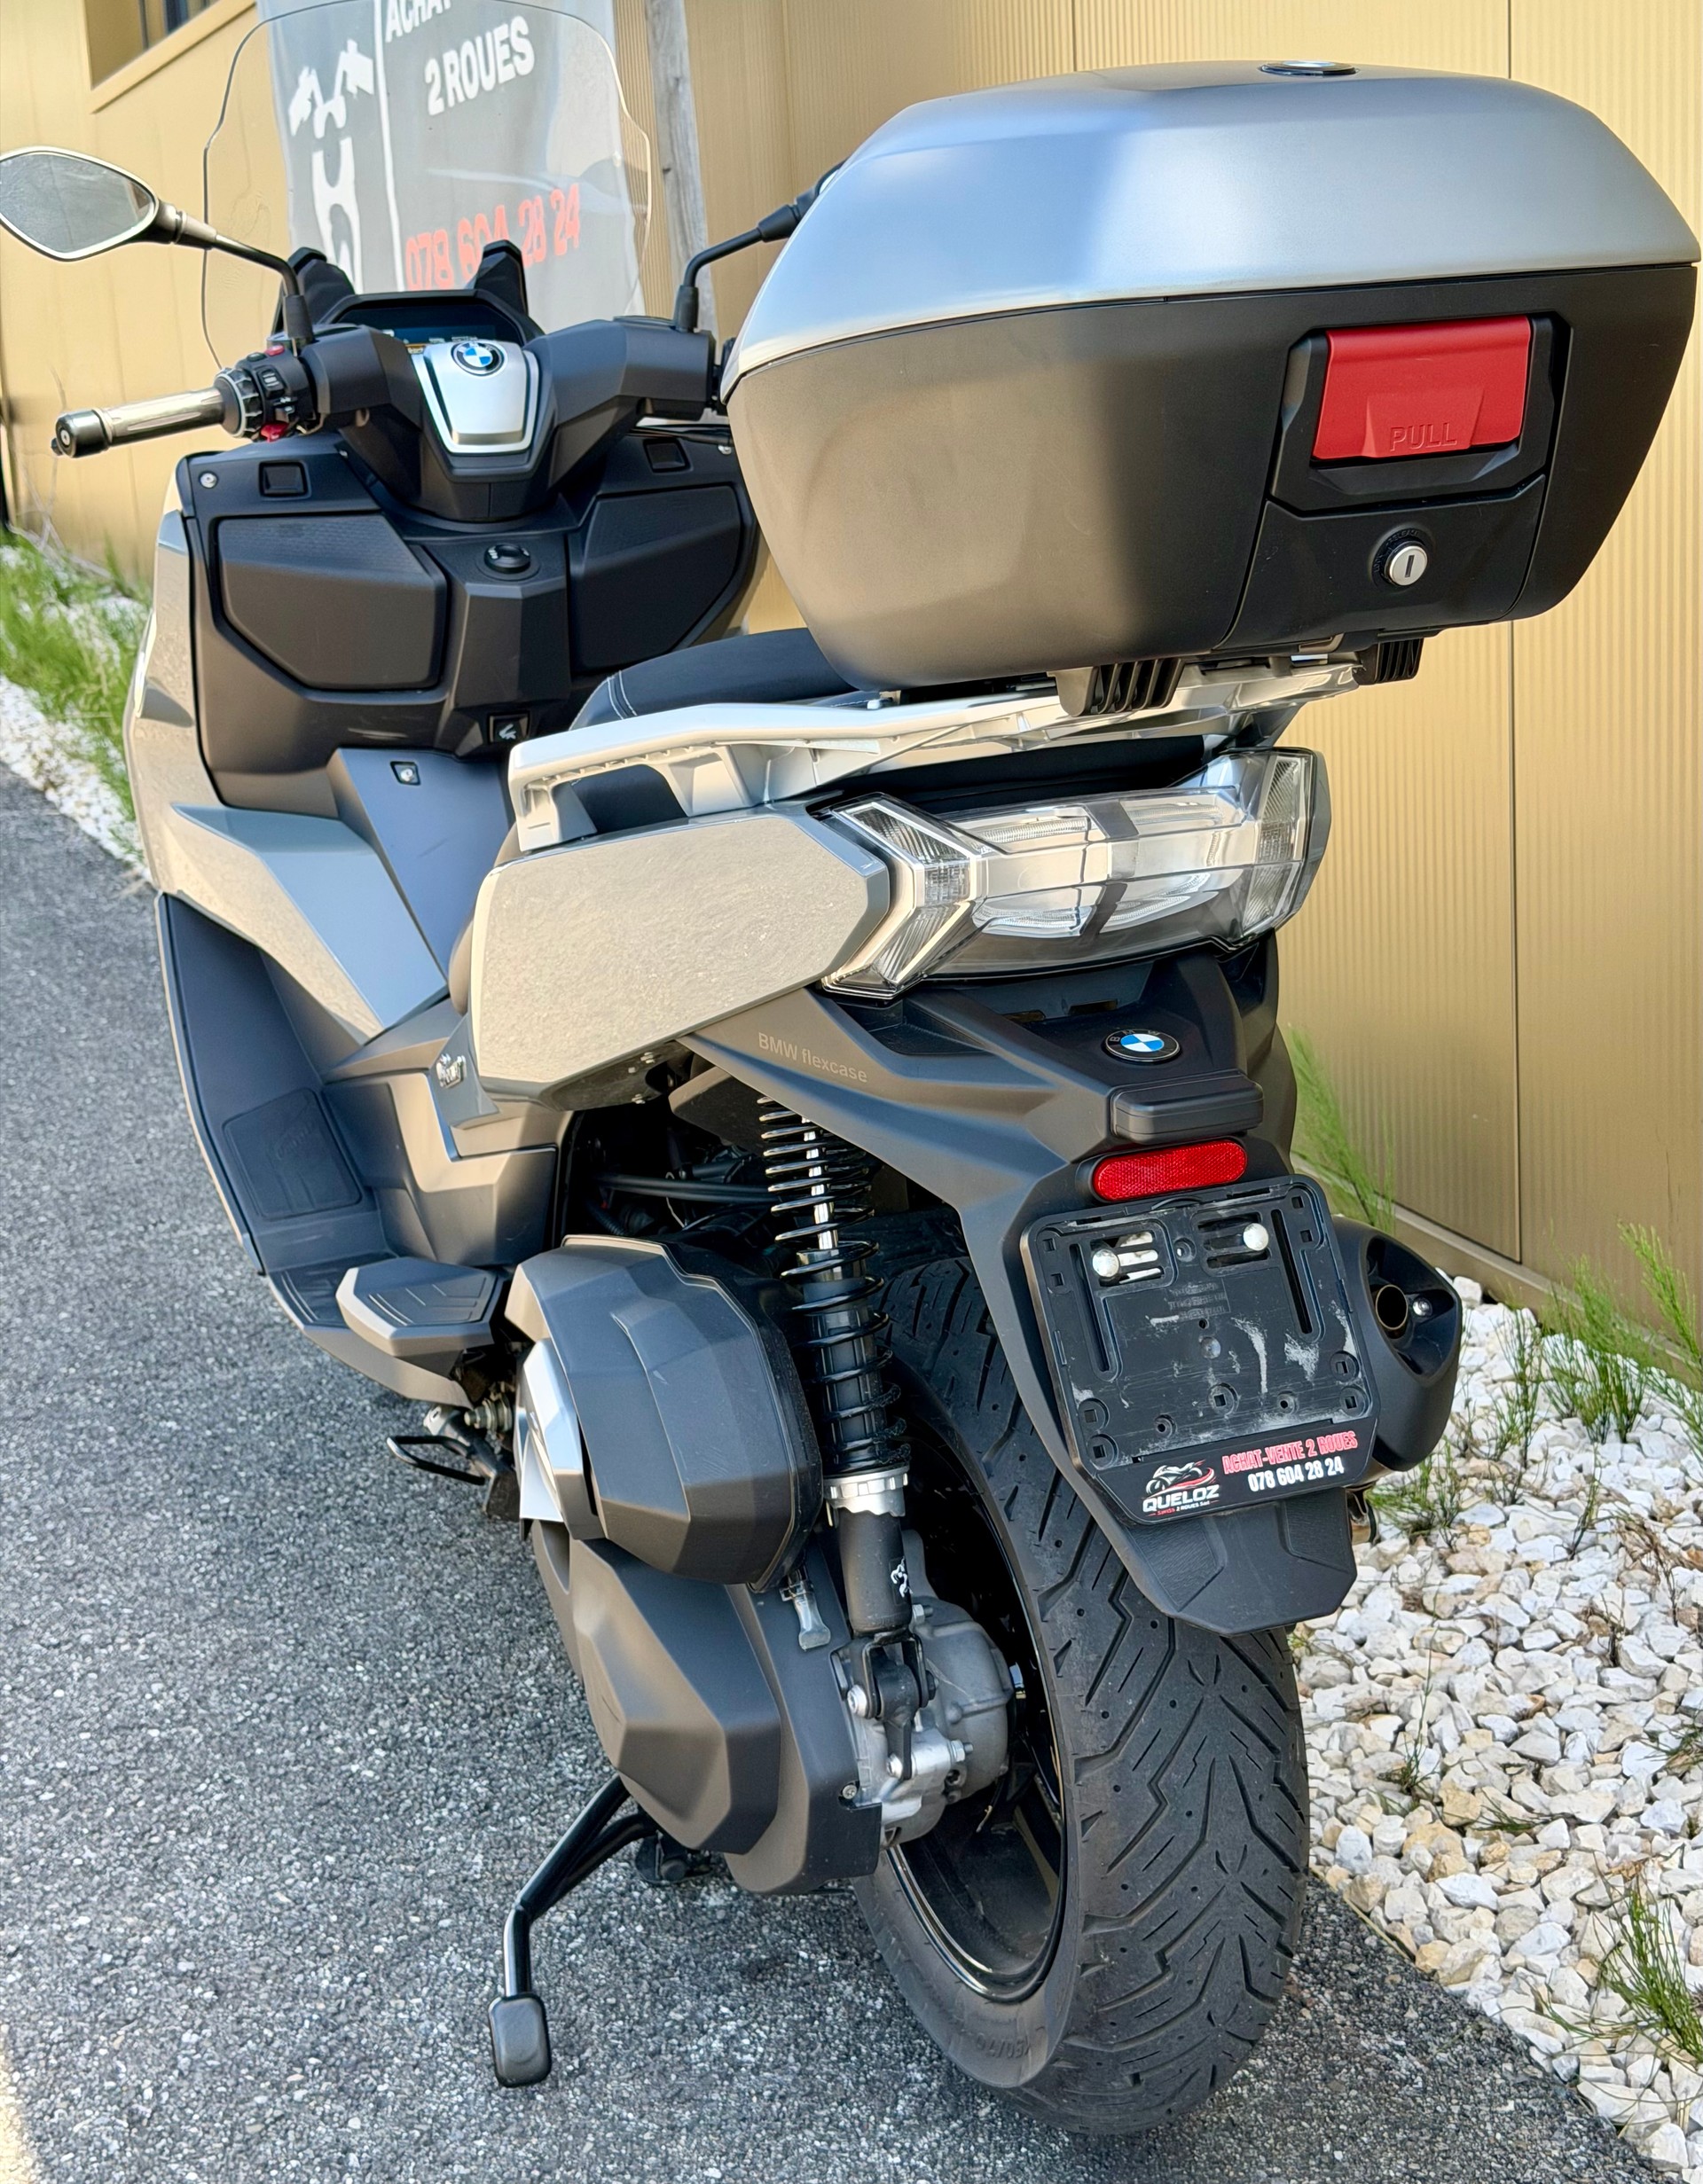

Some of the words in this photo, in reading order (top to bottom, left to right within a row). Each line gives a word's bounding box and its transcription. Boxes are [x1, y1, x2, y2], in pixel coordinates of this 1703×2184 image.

[424, 59, 445, 115] 2
[443, 15, 535, 107] ROUES
[405, 229, 455, 291] 078
[518, 195, 547, 270] 28
[550, 183, 581, 256] 24
[1389, 422, 1458, 452] PULL
[758, 1032, 797, 1061] BMW
[802, 1048, 867, 1083] flexcase
[1222, 1440, 1306, 1475] ACHAT-VENTE
[1306, 1438, 1317, 1458] 2
[1317, 1430, 1358, 1454] ROUES
[1247, 1470, 1275, 1491] 078
[1276, 1464, 1304, 1486] 604
[1305, 1460, 1324, 1480] 28
[1324, 1455, 1345, 1476] 24
[1142, 1484, 1220, 1512] QUELOZ
